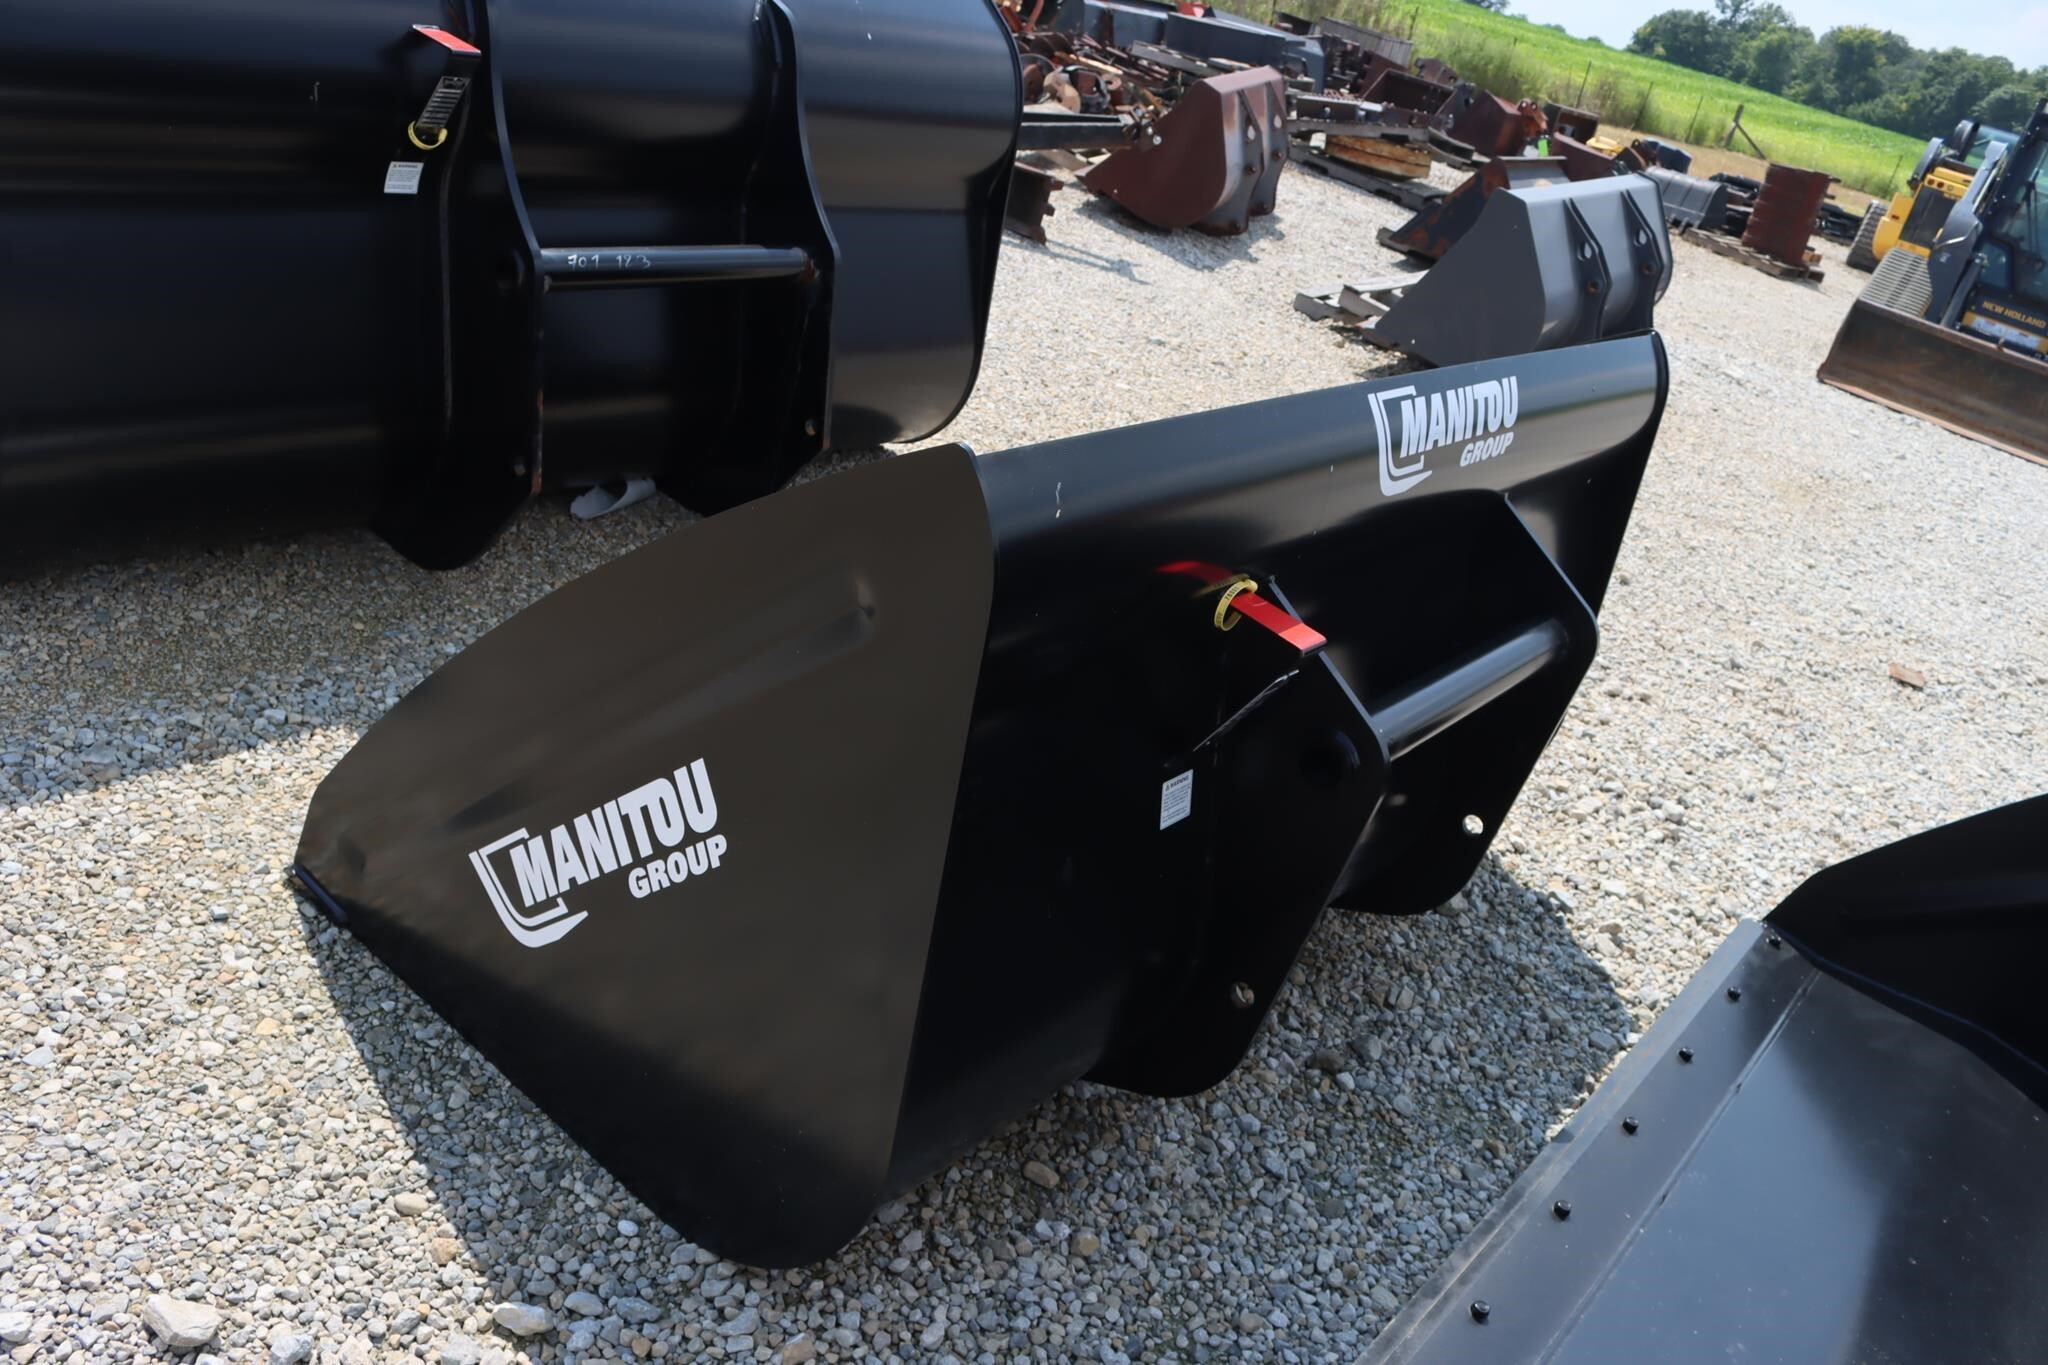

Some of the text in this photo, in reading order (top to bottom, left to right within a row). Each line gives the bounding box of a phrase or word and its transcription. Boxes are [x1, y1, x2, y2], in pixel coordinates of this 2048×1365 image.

[2003, 308, 2047, 328] HOLLAND
[1400, 376, 1519, 459] MANITOU
[1460, 432, 1515, 467] GROUP
[509, 757, 718, 908] MANITOU
[628, 834, 727, 899] GROUP
